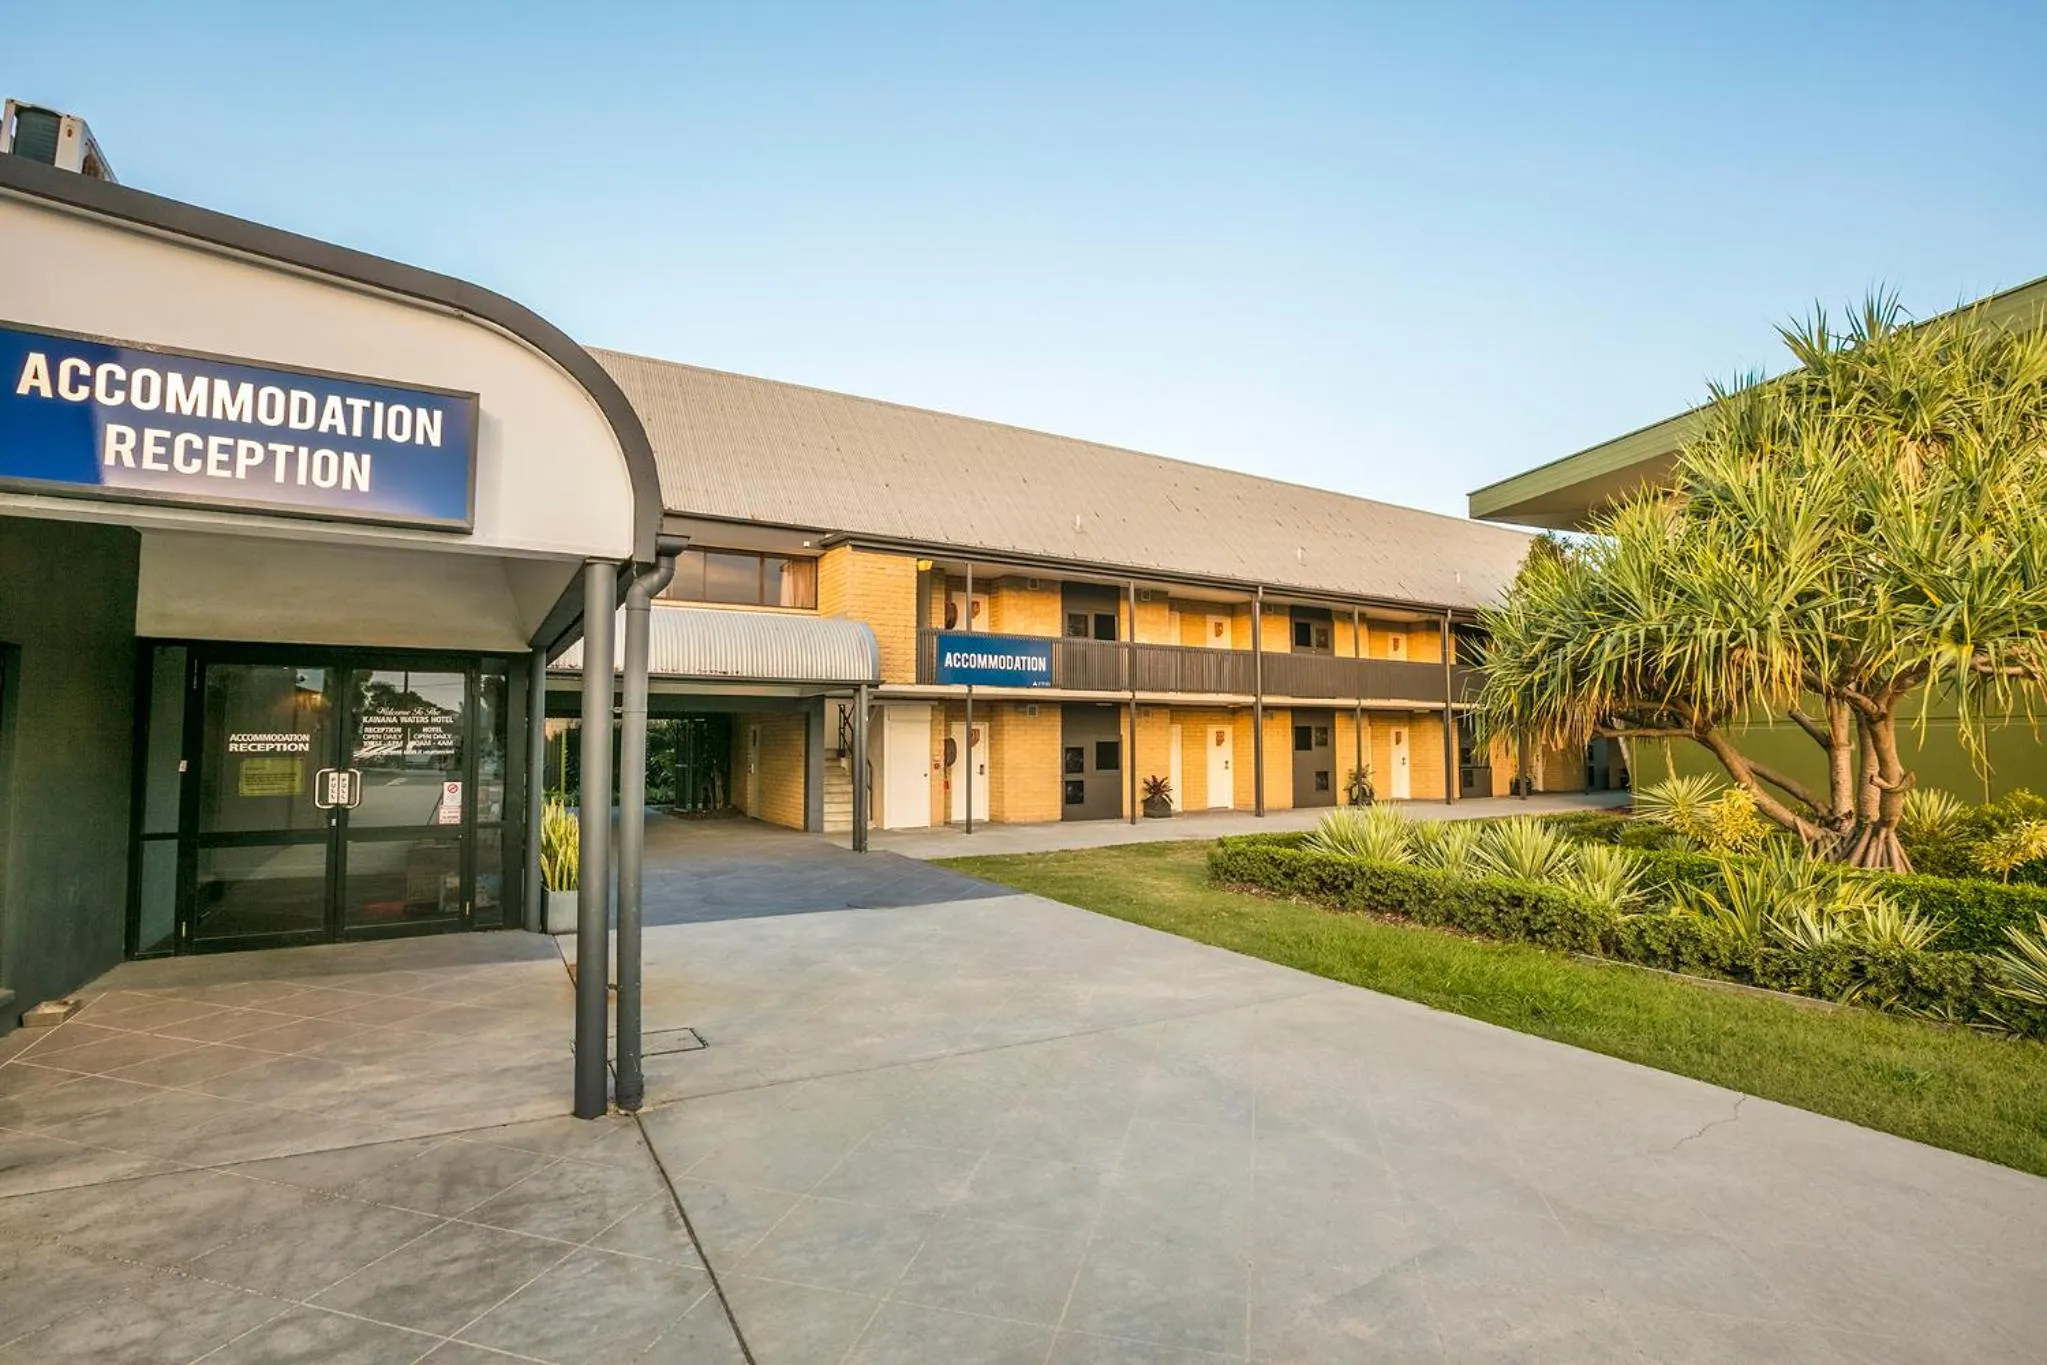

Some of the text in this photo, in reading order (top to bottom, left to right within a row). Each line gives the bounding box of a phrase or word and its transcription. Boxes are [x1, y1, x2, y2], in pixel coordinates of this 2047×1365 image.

[16, 352, 443, 447] ACCOMMODATION
[104, 424, 371, 492] RECEPTION
[944, 652, 1047, 671] ACCOMMODATION
[399, 715, 430, 723] WATERS
[431, 715, 454, 723] HOTEL
[364, 726, 402, 734] RECEPTION
[422, 726, 443, 734] HOTEL
[229, 733, 310, 741] ACCOMMODATION
[228, 742, 310, 752] RECEPTION
